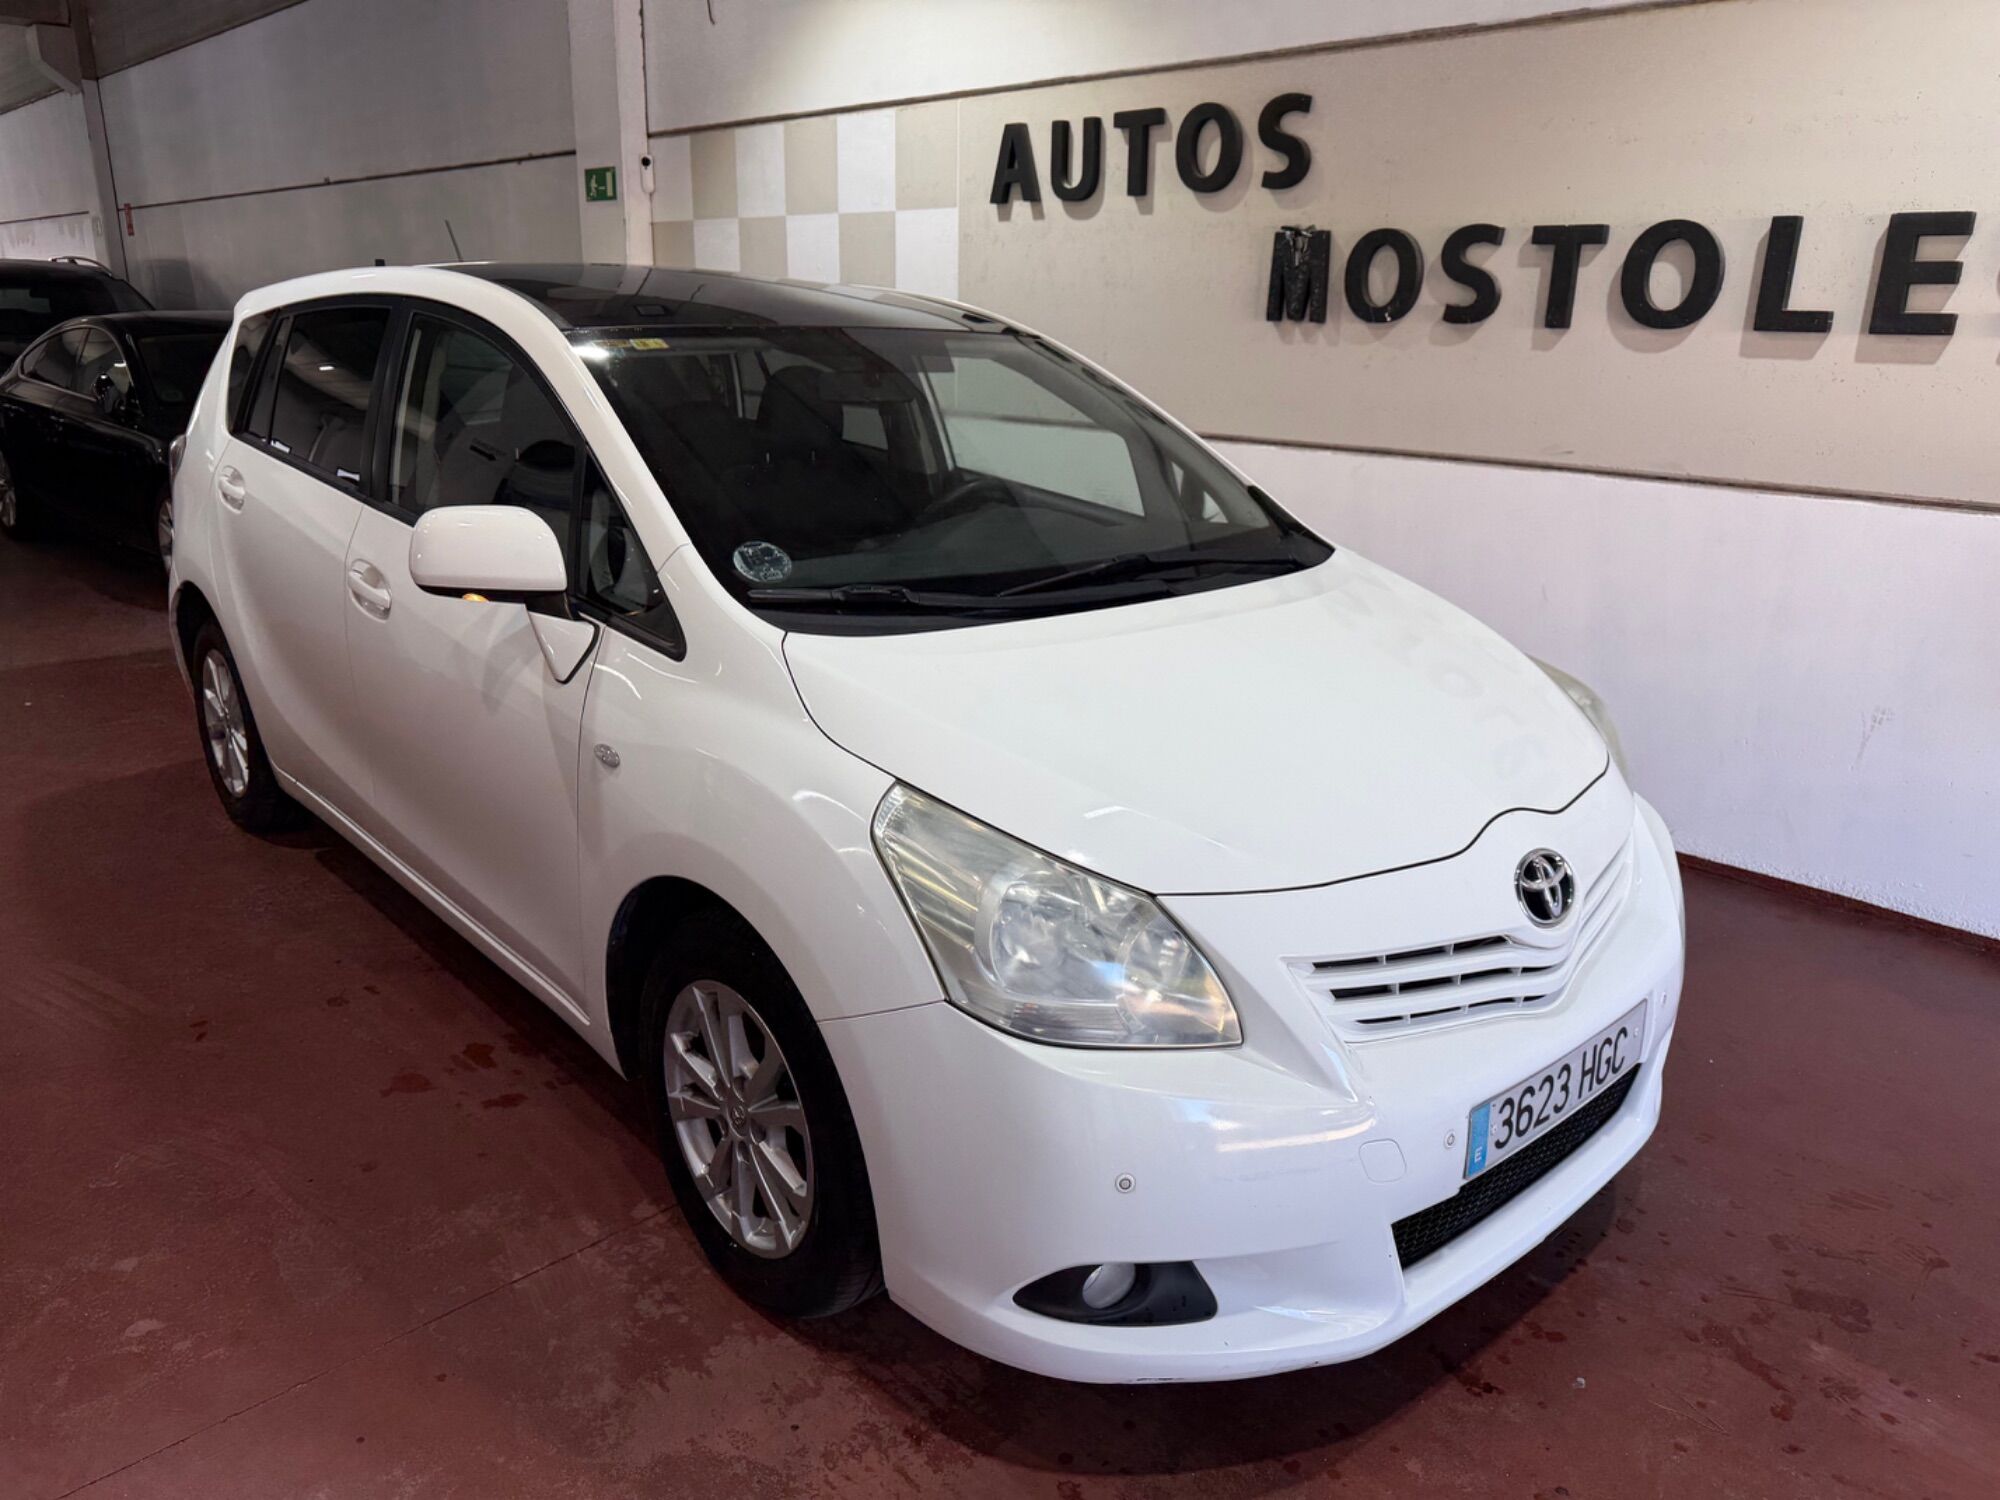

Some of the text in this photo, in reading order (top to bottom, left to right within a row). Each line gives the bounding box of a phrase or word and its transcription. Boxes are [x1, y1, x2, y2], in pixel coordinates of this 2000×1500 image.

[990, 93, 1312, 204] AUTOS
[1494, 1026, 1628, 1149] 3623 HGC
